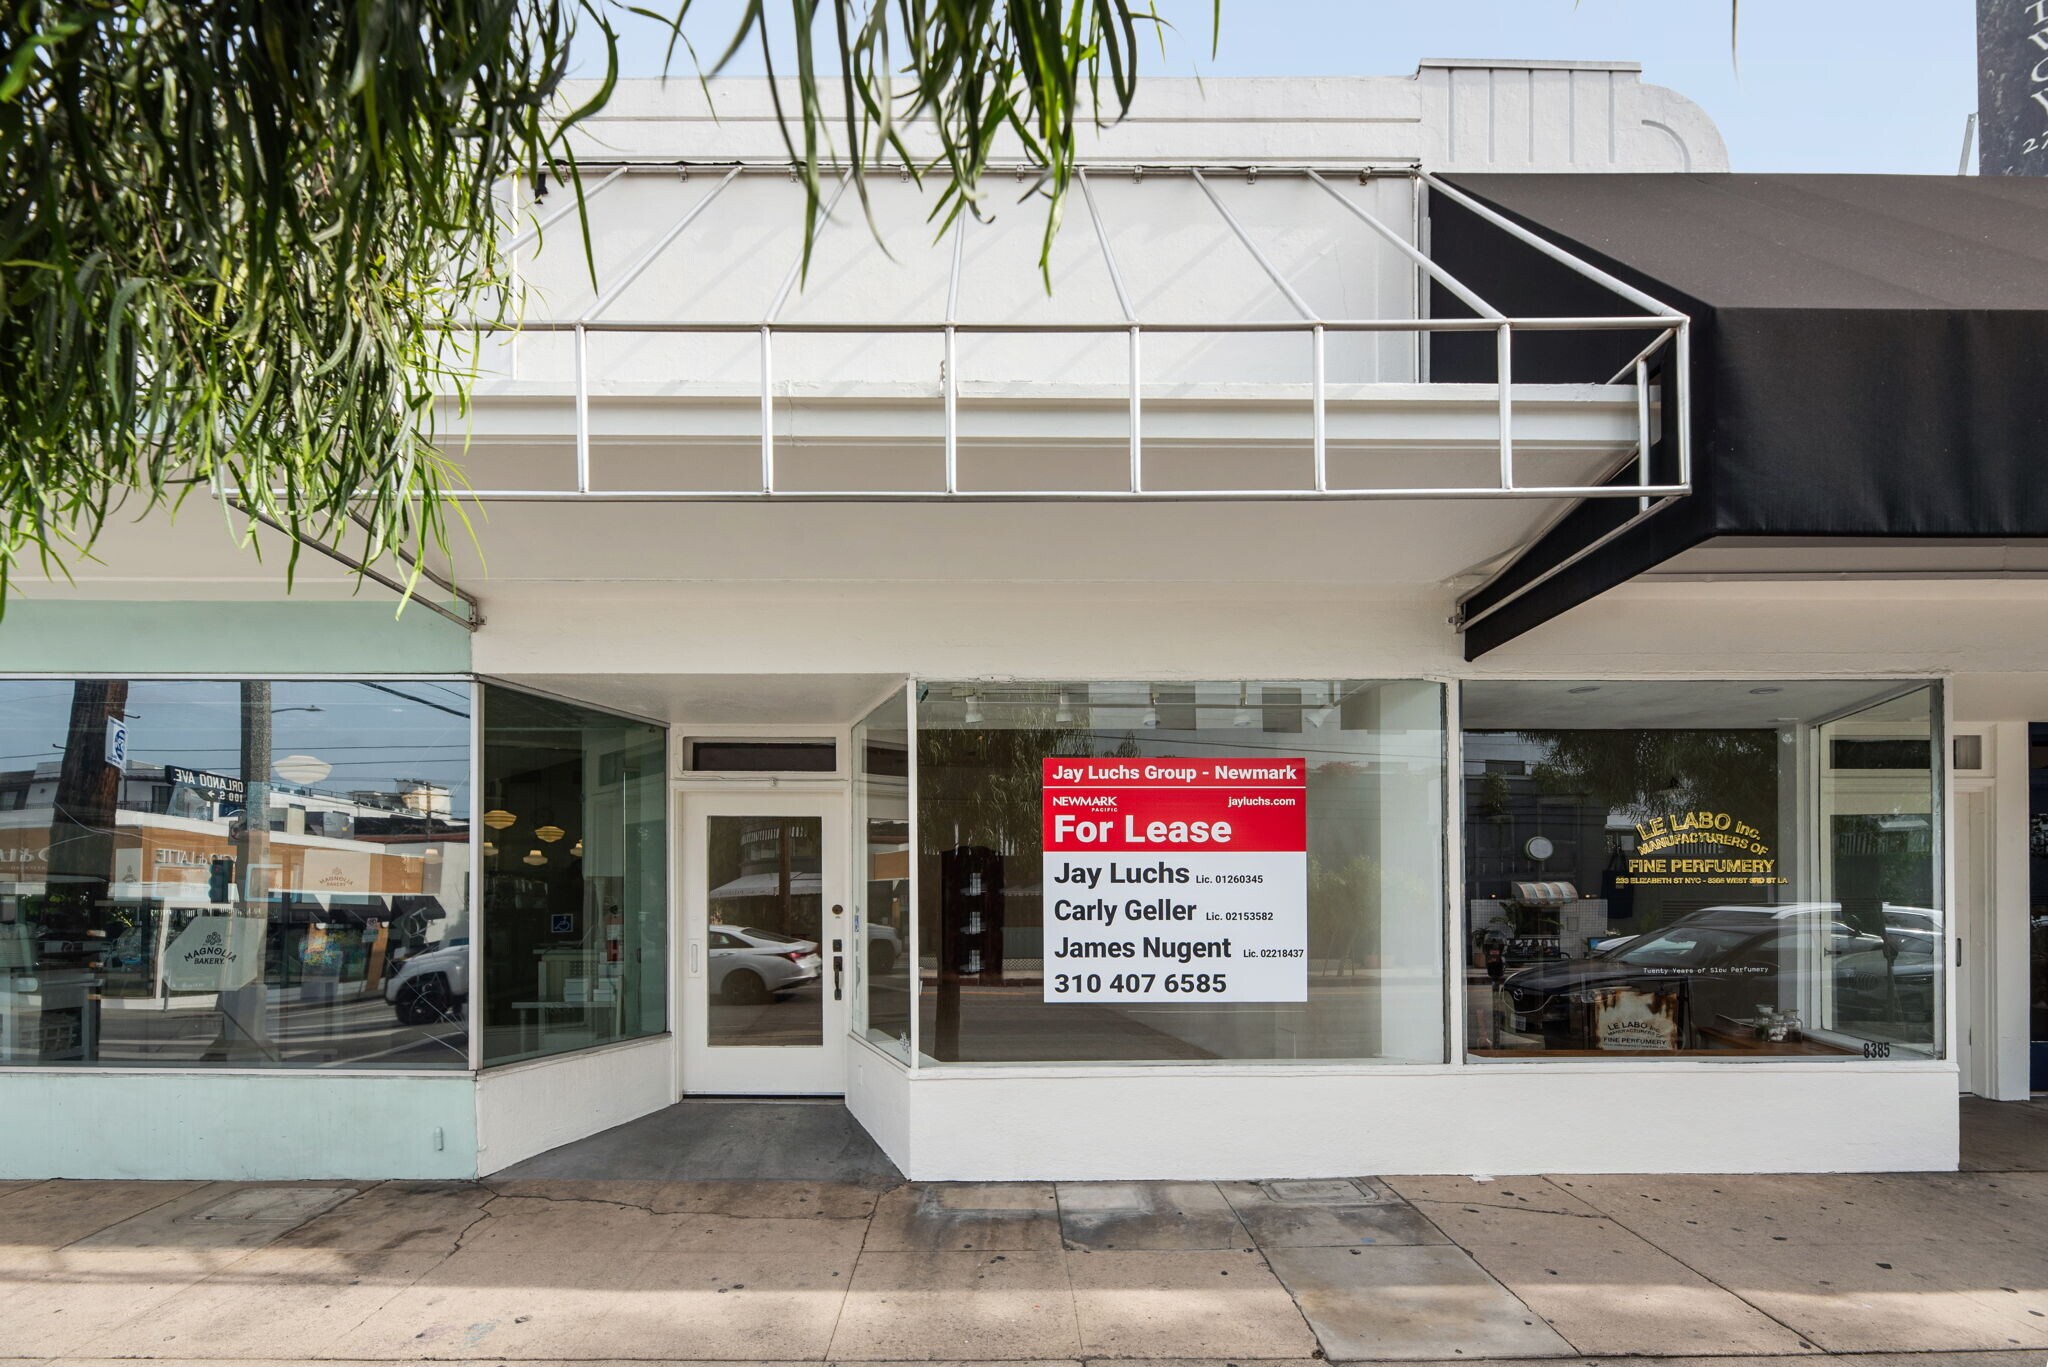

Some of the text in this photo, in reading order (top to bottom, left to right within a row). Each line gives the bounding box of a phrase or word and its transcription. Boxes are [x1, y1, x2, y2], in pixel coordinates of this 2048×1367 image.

[1052, 765, 1084, 783] Jay
[1088, 765, 1140, 779] Luchs
[1144, 765, 1197, 783] Group
[1215, 765, 1297, 780] Newmark
[1052, 796, 1118, 806] NEWMARK
[1227, 796, 1296, 808] jayluchs.com
[1055, 815, 1232, 843] For Lease
[1636, 816, 1667, 841] LE
[1669, 811, 1732, 833] LABO
[1637, 832, 1769, 856] MANUFACTURERS OF
[1628, 859, 1775, 873] FINE PERFUMERY
[1054, 861, 1264, 889] Jay Luchs Lic. 01260345
[1054, 898, 1274, 926] Carly Geller Lic. 02153582
[184, 946, 237, 962] MAGNOLIA
[1054, 937, 1304, 963] James Nugent Lic. 02218437
[1730, 966, 1769, 974] Perfumery
[1054, 973, 1227, 993] 310 407 6585
[1607, 1022, 1620, 1031] LE
[1621, 1021, 1648, 1029] LABO
[1621, 1037, 1667, 1045] PERFUMERY
[1863, 1042, 1890, 1059] 8385
